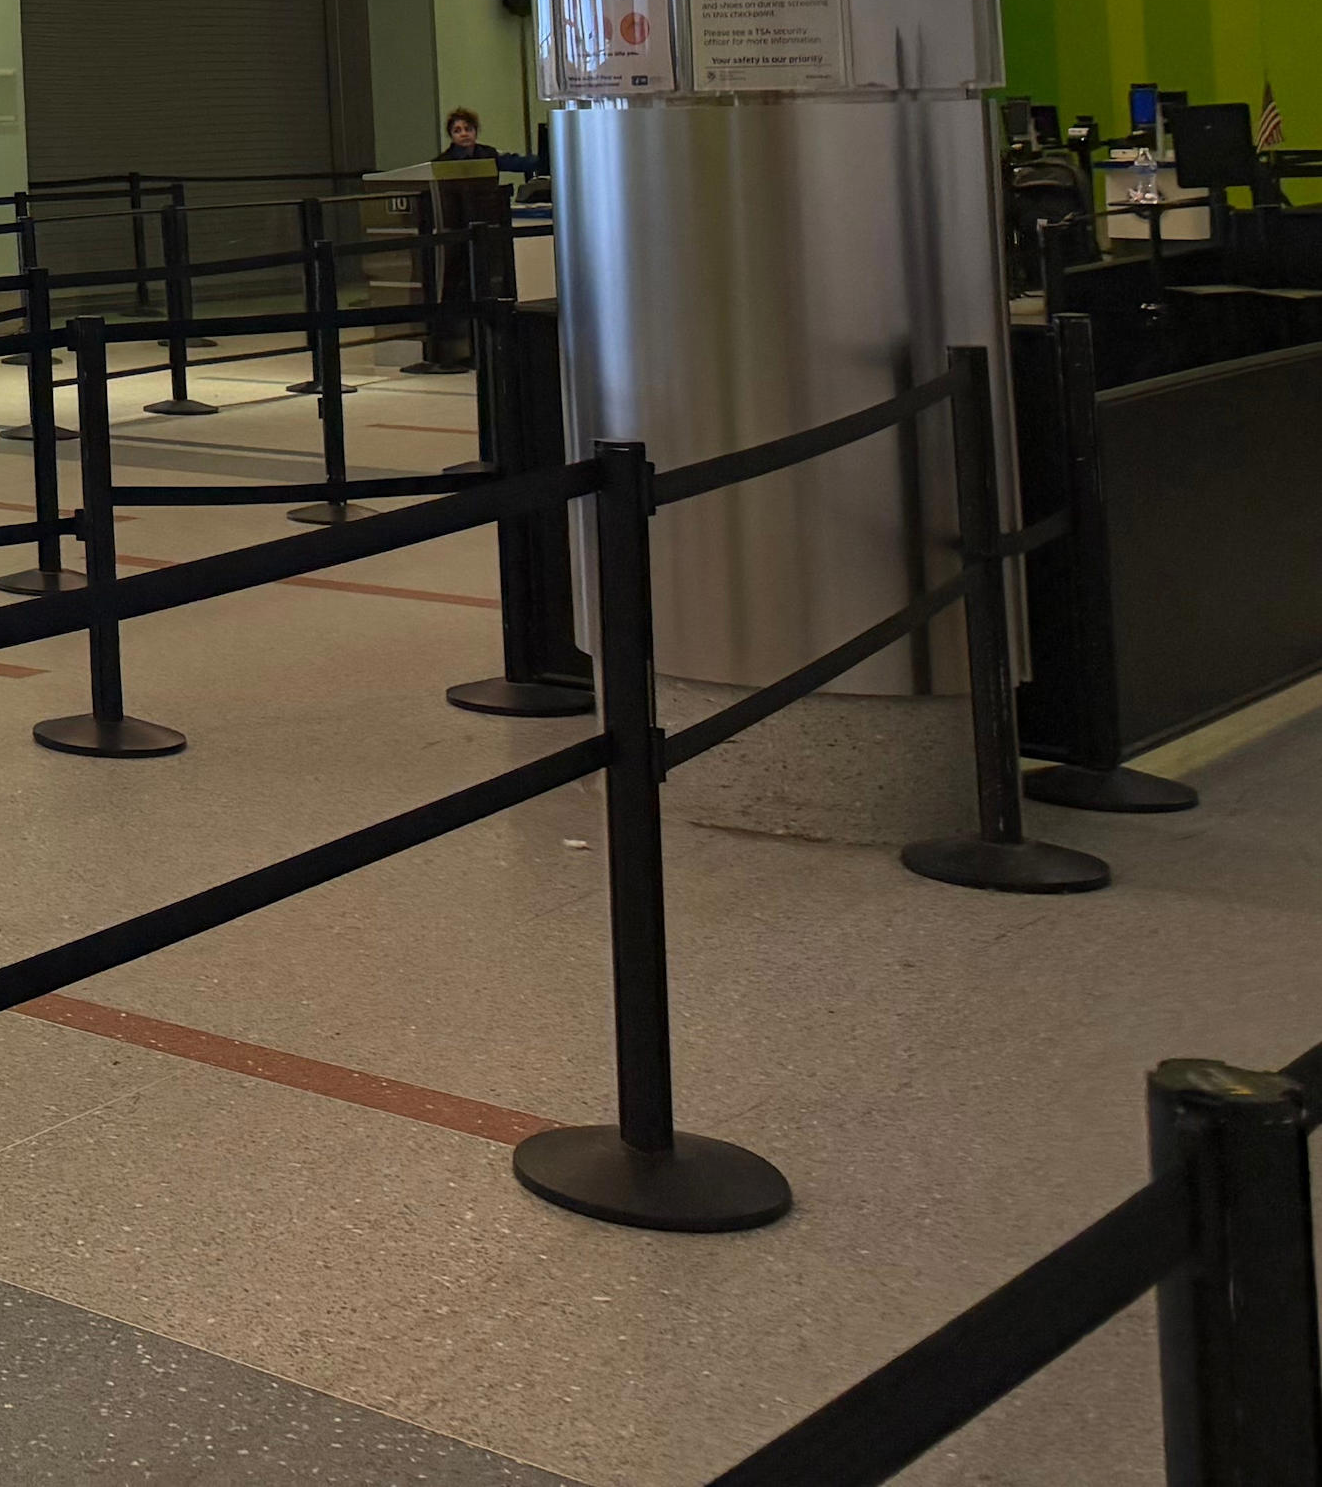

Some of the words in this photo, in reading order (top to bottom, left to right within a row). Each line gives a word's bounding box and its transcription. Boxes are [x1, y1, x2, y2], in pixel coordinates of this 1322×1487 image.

[733, 56, 760, 64] safety
[789, 55, 823, 63] priority
[391, 197, 407, 211] 10
